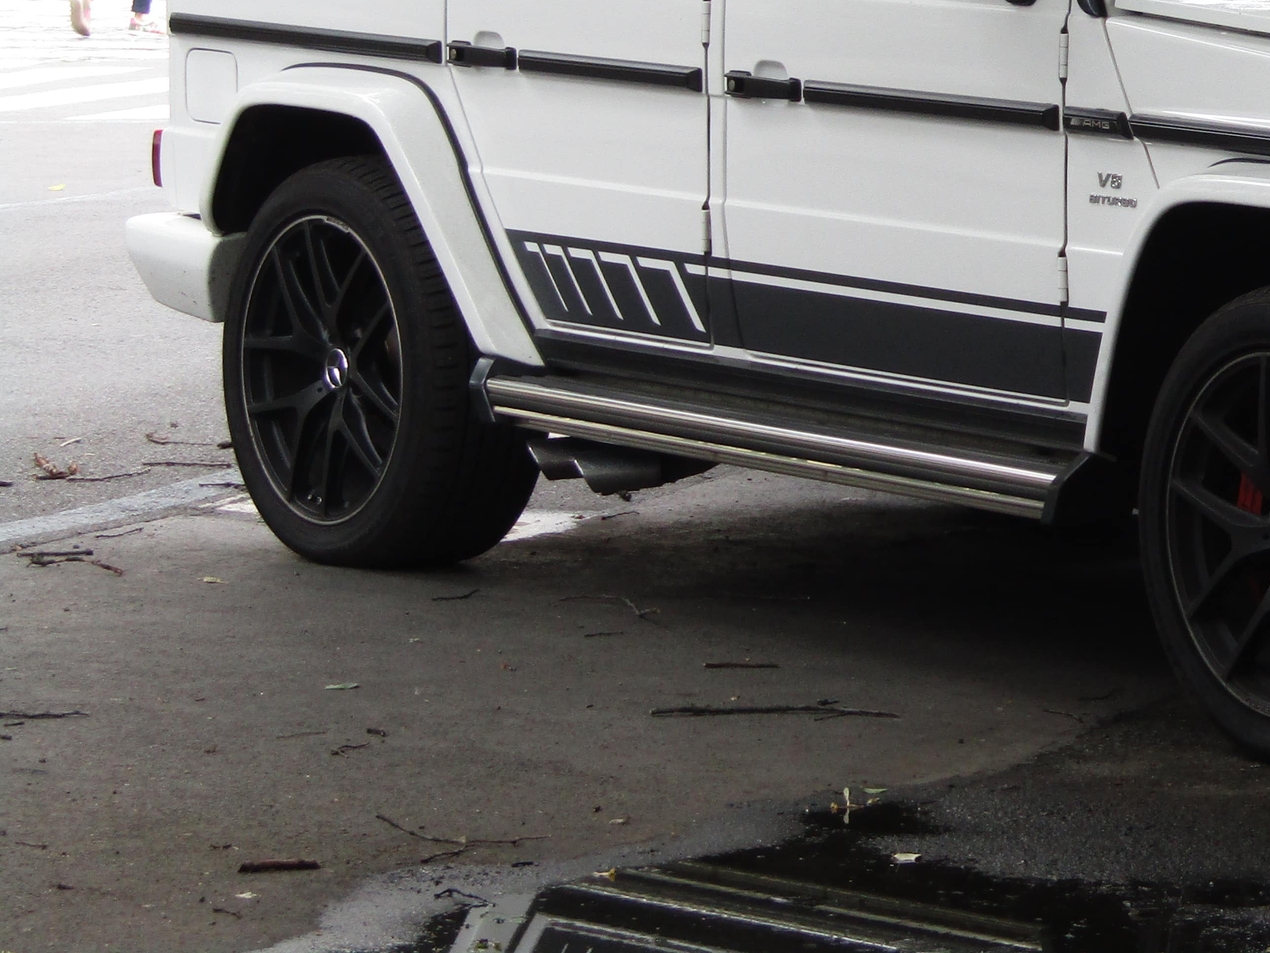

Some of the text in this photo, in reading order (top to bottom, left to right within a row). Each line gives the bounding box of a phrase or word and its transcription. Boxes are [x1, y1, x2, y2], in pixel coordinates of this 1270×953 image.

[1082, 119, 1110, 130] AMG
[1096, 171, 1123, 190] V8
[1089, 193, 1138, 209] BITURBO
